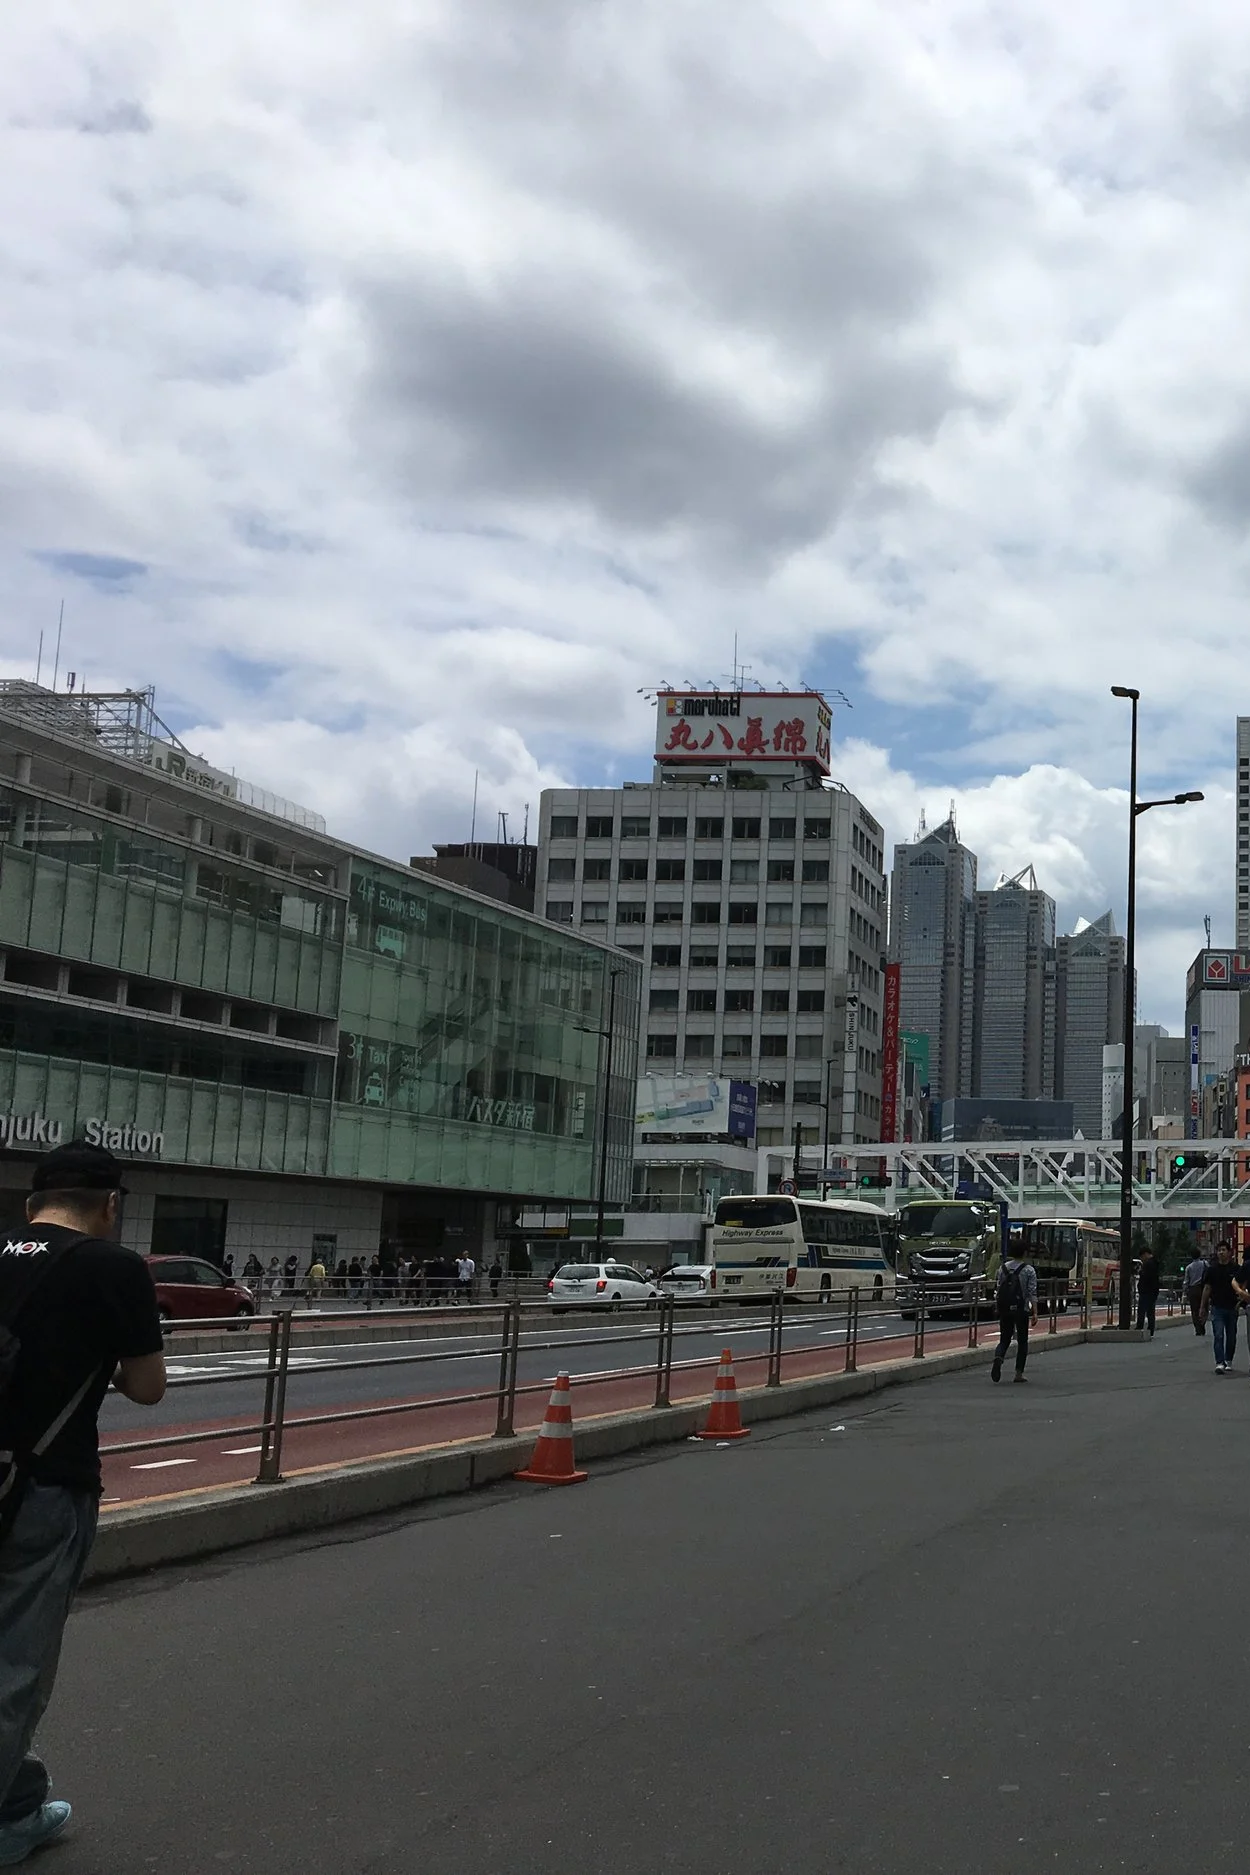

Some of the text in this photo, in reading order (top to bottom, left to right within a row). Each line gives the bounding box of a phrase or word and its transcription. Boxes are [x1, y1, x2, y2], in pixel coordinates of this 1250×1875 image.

[466, 1095, 536, 1131] バスタ新宿
[85, 1117, 165, 1154] Station
[722, 1229, 783, 1238] Highway Express
[2, 1239, 50, 1257] MOX
